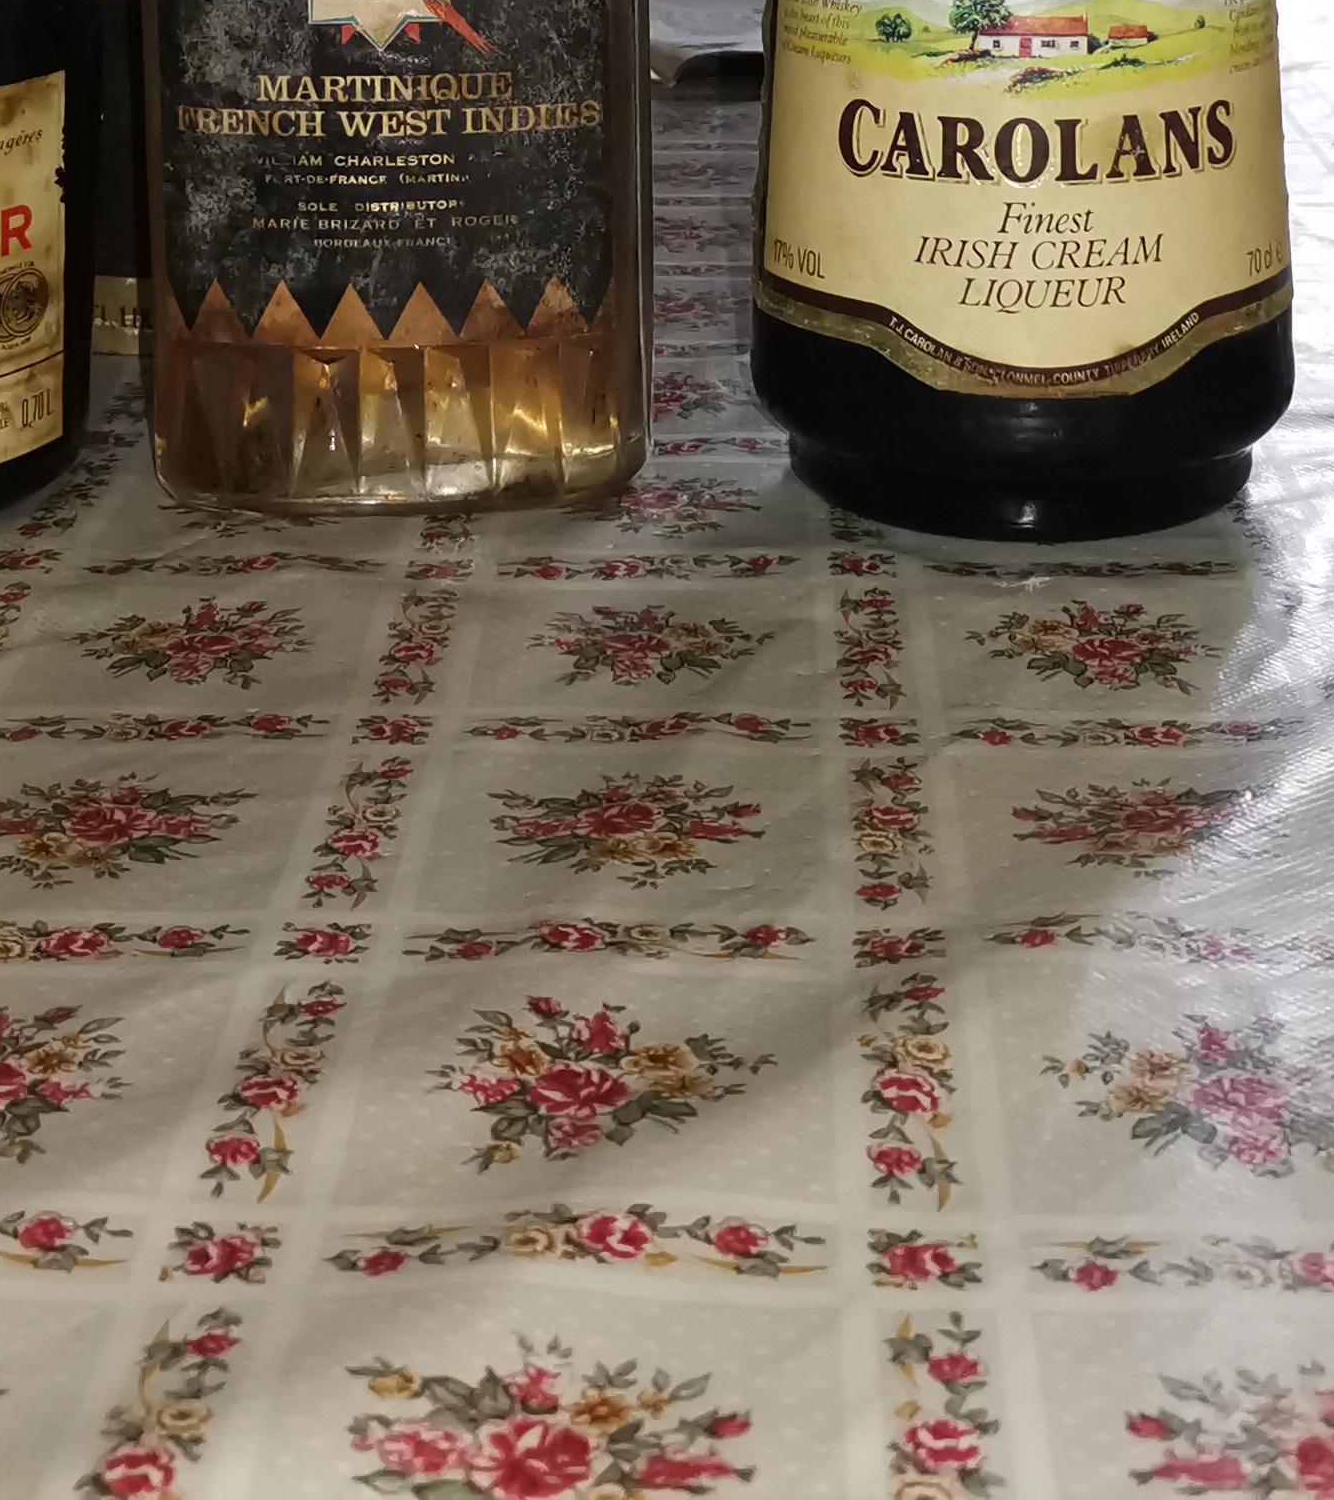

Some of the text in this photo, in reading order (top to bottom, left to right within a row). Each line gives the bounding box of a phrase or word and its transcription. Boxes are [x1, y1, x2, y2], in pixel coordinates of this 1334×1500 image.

[256, 71, 513, 102] MARTINIQUE
[177, 100, 604, 137] FRENCH WEST INDIES
[838, 98, 1237, 185] CAROLANS
[334, 153, 456, 167] CHARLESTON
[252, 216, 310, 231] MARIE
[318, 218, 400, 231] BRIZARD
[414, 217, 437, 229] ET
[297, 202, 338, 212] SOLE
[996, 201, 1095, 235] Finest
[774, 238, 825, 279] 17% VOL
[914, 232, 1165, 270] IRISH CREAM
[1246, 247, 1261, 277] 70
[958, 275, 1126, 314] LIQUEUR
[904, 328, 953, 363] CAROLAN
[1161, 312, 1200, 349] IRELAND
